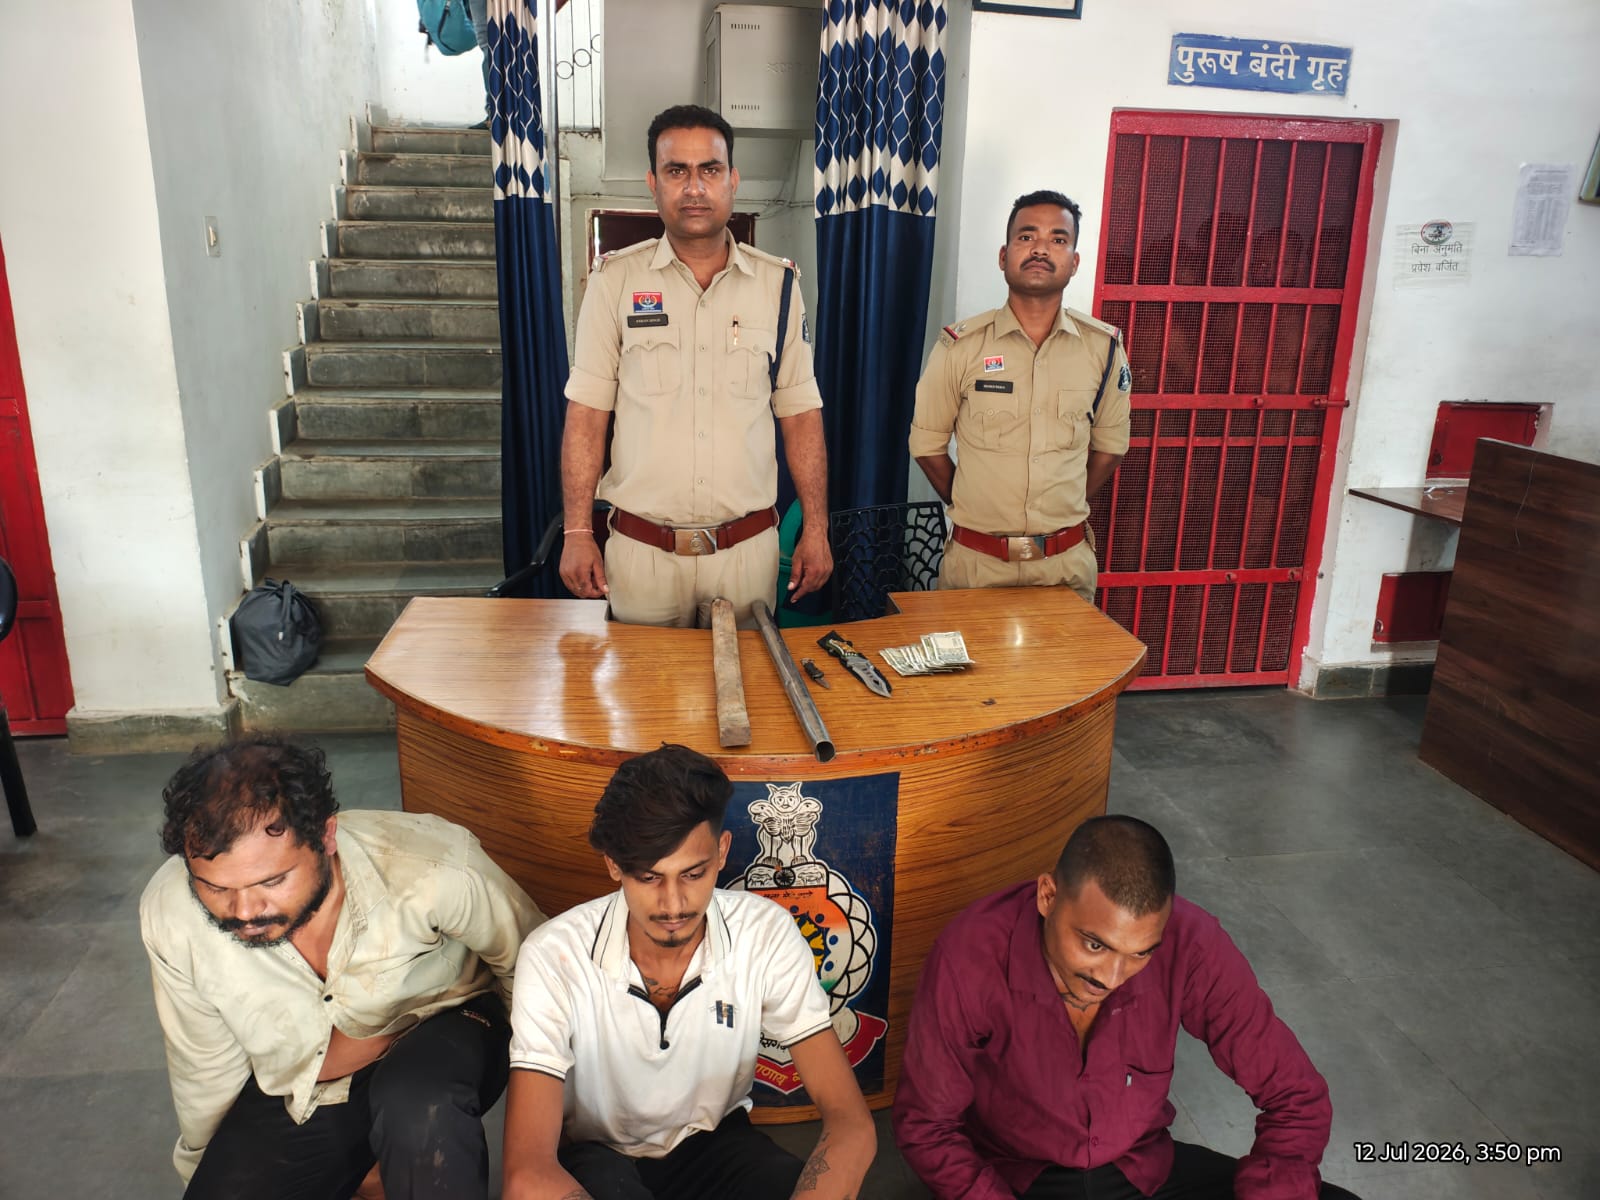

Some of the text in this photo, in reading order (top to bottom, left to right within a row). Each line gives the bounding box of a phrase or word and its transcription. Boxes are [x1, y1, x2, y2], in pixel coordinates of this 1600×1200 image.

[1174, 43, 1347, 91] पुरूष बंदी गृह
[1411, 240, 1463, 257] बिना अनुमति
[1411, 259, 1459, 273] प्रवेश वर्जित
